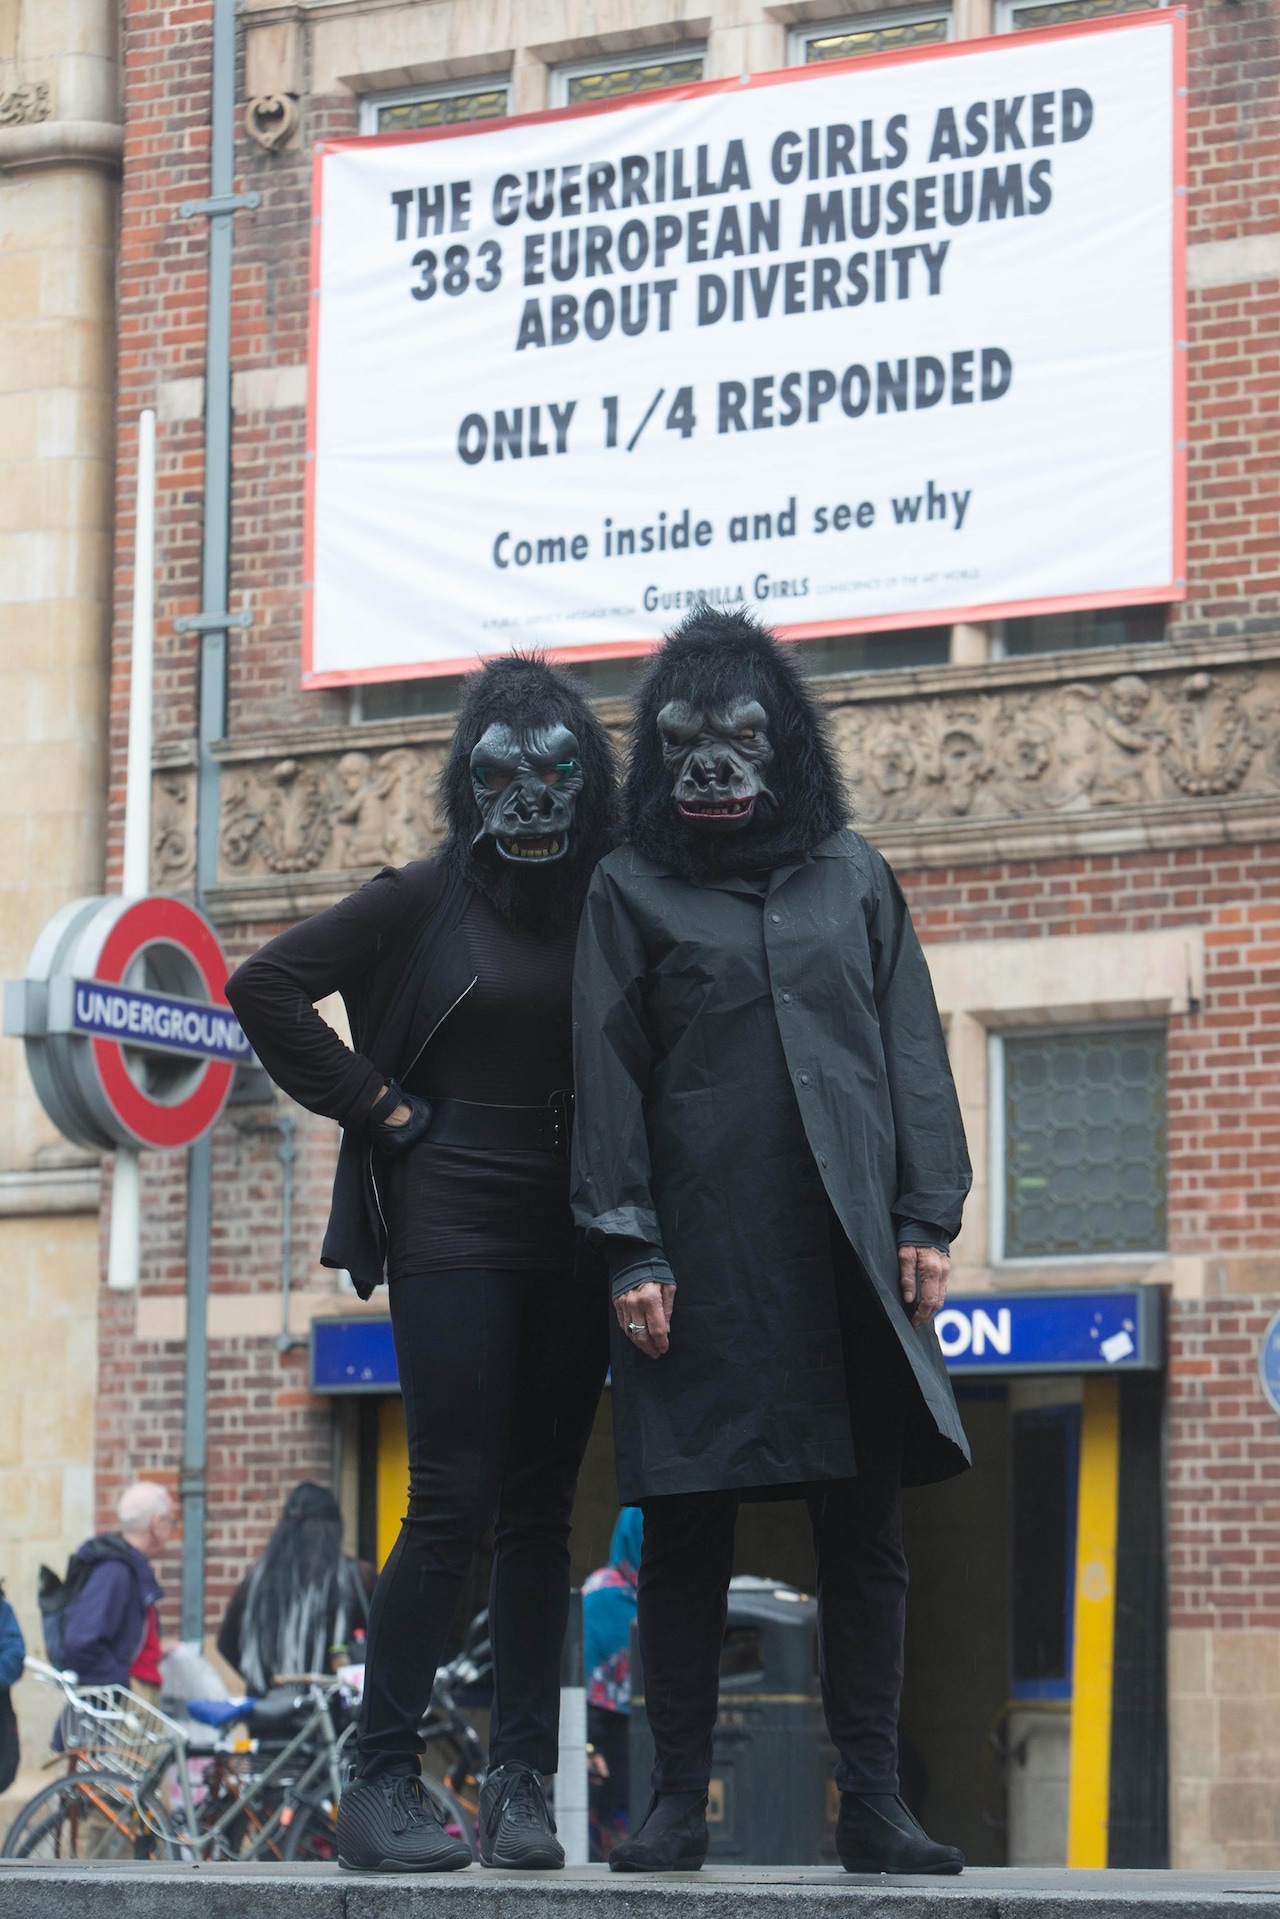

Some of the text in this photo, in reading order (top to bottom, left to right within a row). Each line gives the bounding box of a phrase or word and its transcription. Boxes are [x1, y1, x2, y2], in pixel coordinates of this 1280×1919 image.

[391, 87, 1094, 241] THE GUERRILLA GIRLS ASKED
[411, 158, 1052, 302] 383 EUROPEAN MUSEUMS
[515, 240, 951, 351] ABOUT DIVERSITY
[457, 347, 1013, 466] ONLY 1/4 RESPONDED
[493, 480, 972, 569] Come inside and see why
[755, 573, 809, 600] GIRLS
[77, 990, 250, 1051] UNDERGROUND
